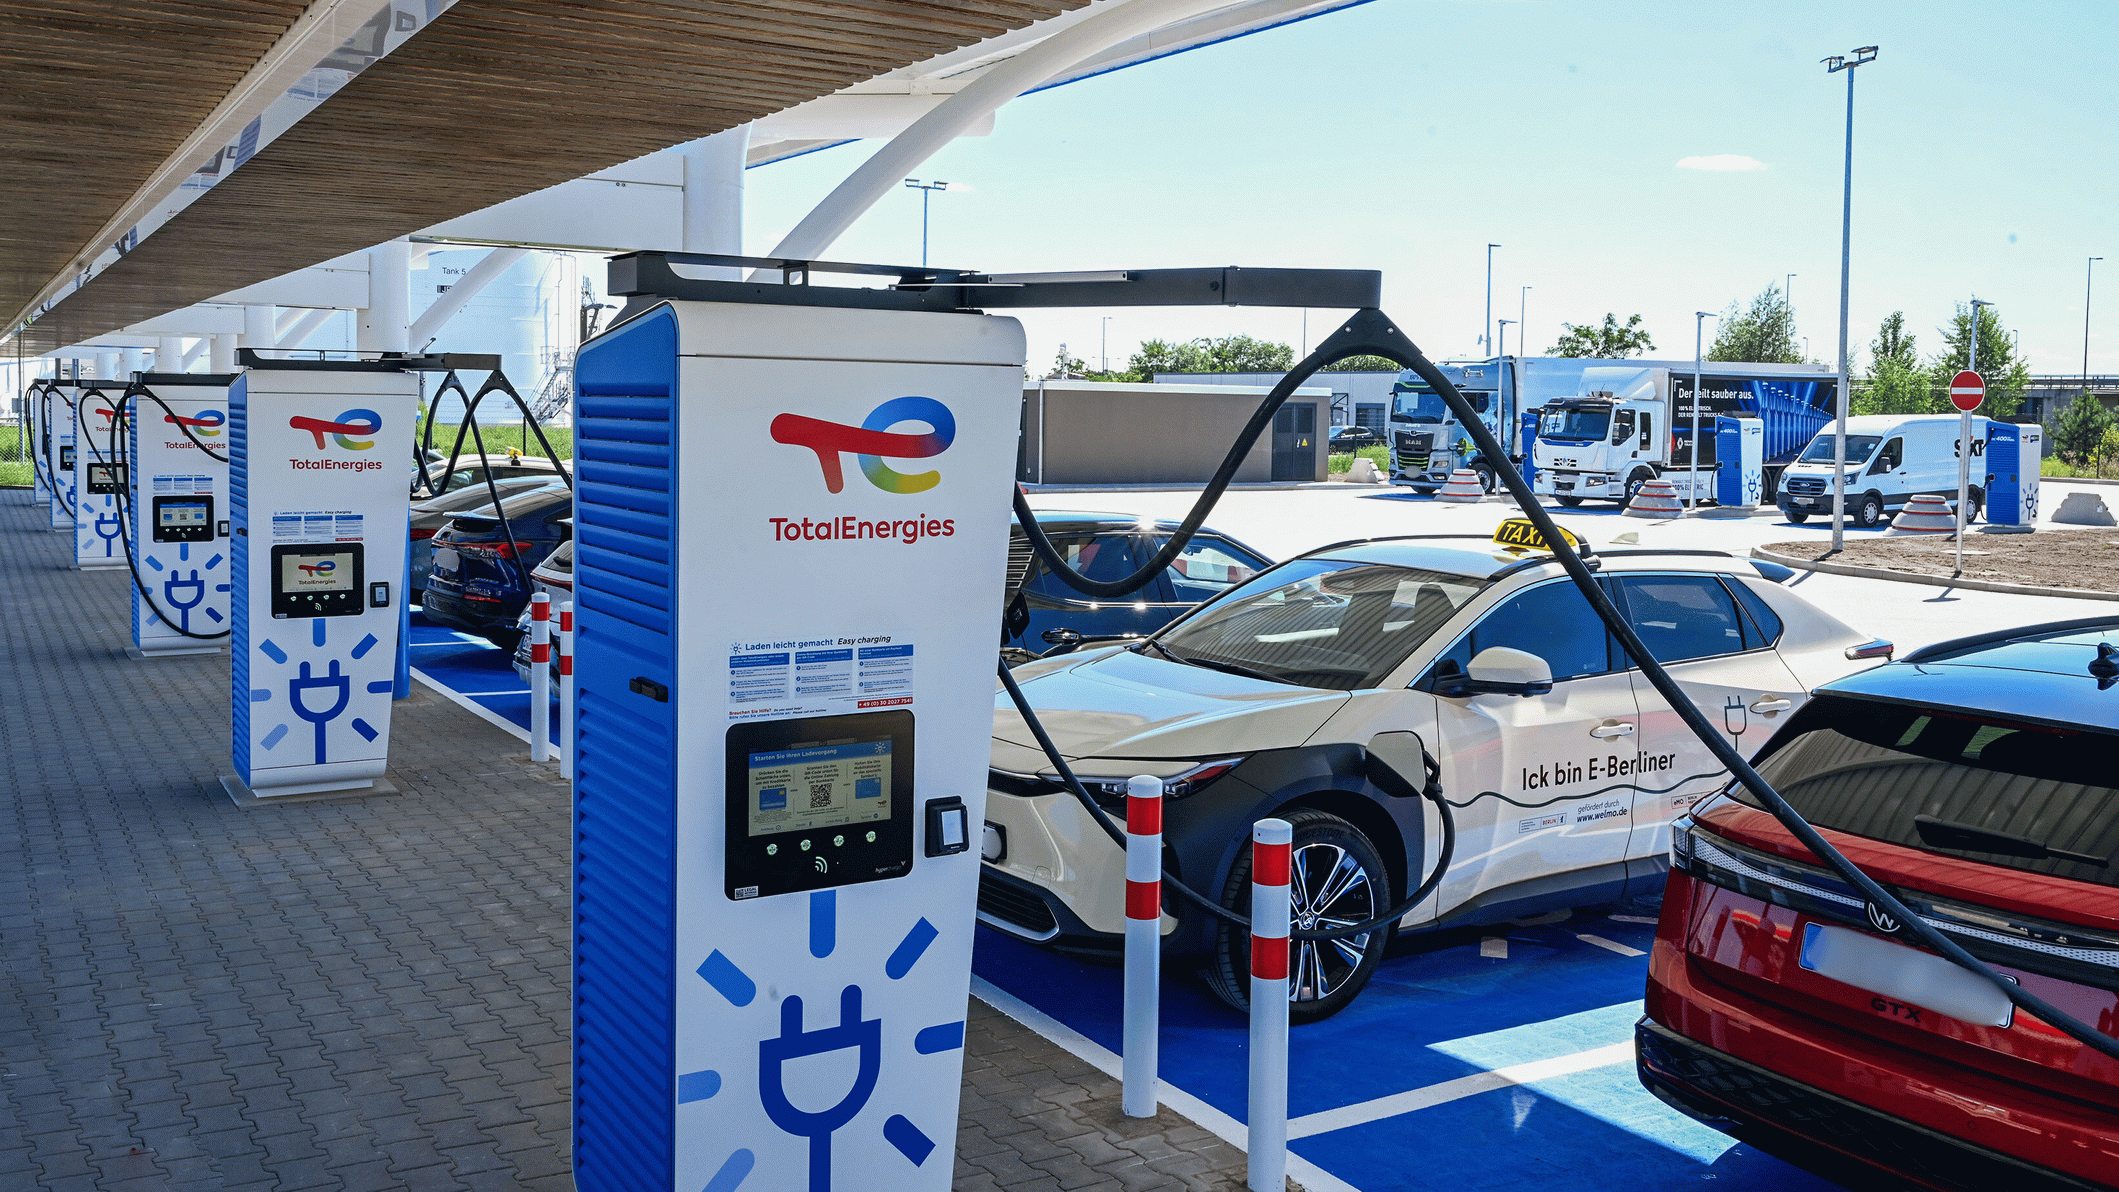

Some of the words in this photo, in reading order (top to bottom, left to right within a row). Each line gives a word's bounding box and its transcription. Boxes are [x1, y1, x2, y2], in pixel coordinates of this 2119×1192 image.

[1679, 388, 1693, 399] Der
[1711, 389, 1737, 399] sauber
[1738, 391, 1754, 399] aus.
[1954, 436, 1984, 457] SXT
[289, 458, 382, 472] TotalEnergies
[769, 513, 955, 544] TotalEnergies
[1503, 523, 1543, 545] TAXI
[745, 643, 771, 651] Laden
[773, 641, 796, 649] leicht
[798, 639, 833, 649] gemacht
[837, 637, 856, 646] Easy
[858, 636, 891, 644] charging
[802, 749, 837, 757] Ladevorgang
[1522, 764, 1549, 790] Ick
[1555, 761, 1582, 785] bin
[1589, 750, 1675, 780] E-Berliner
[1577, 807, 1628, 822] www.welmo.de
[1578, 802, 1603, 815] gefördert
[1604, 799, 1620, 808] durch
[1870, 997, 1921, 1023] GTX
